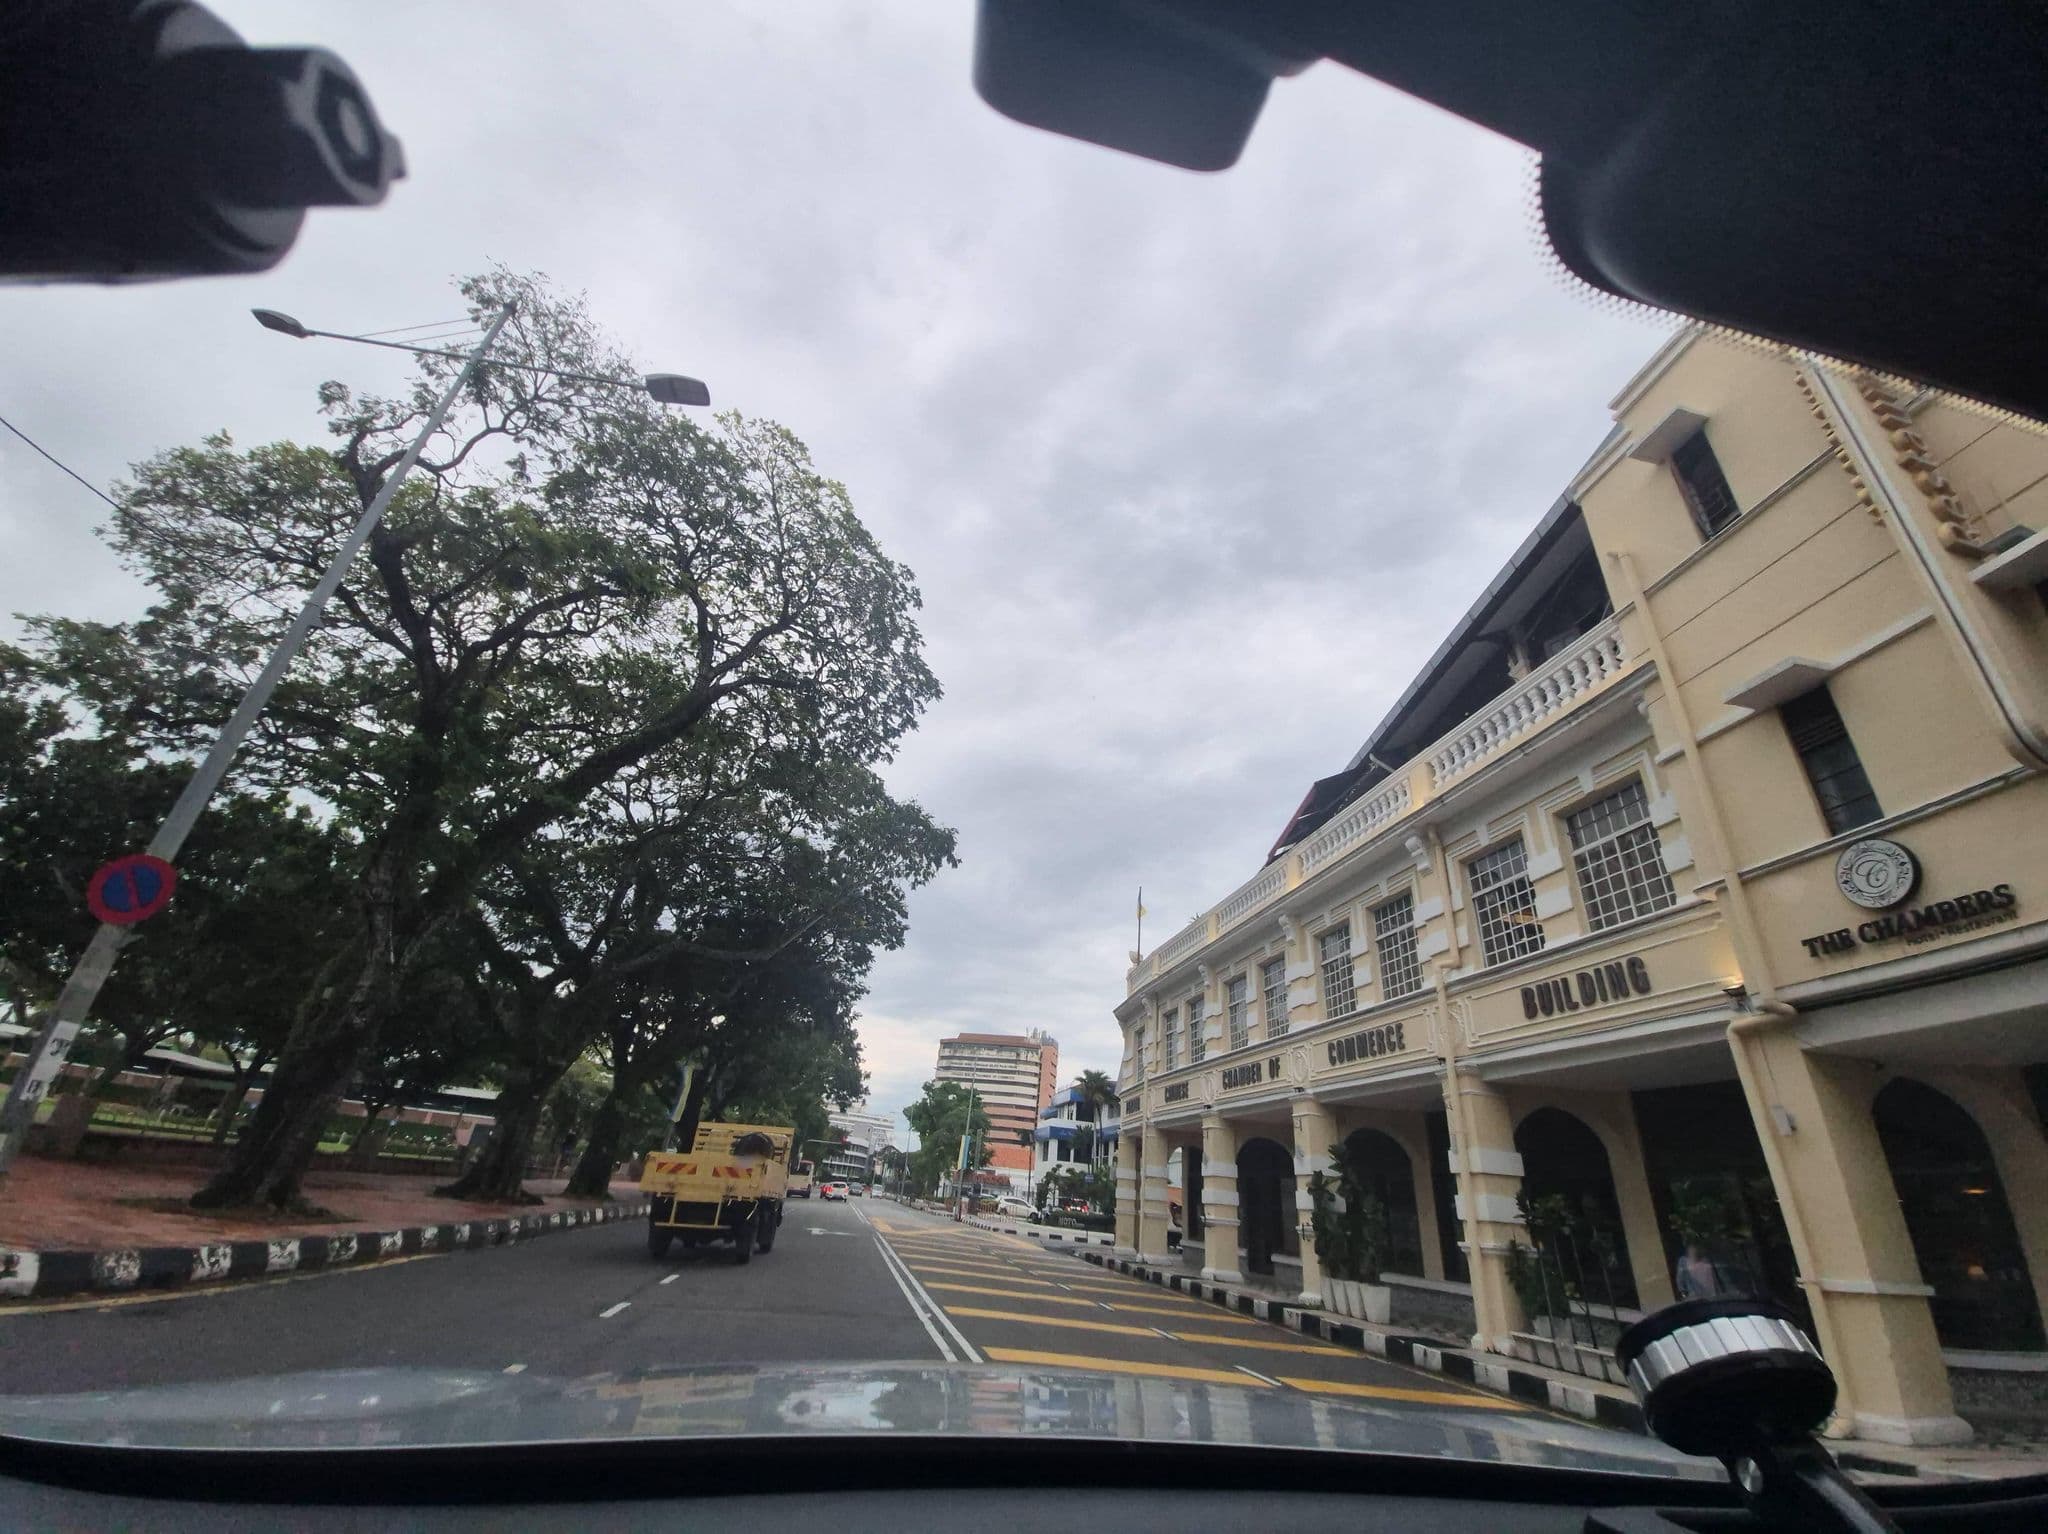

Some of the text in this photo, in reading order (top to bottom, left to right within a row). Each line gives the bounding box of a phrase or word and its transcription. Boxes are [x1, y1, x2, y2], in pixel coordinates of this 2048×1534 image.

[1801, 883, 2016, 958] THE CHAMBERS
[1222, 1062, 1262, 1090] CHAMBER
[1268, 1056, 1281, 1080] OF
[1327, 1022, 1406, 1067] COMMERCE
[1520, 956, 1652, 1020] BUILDING
